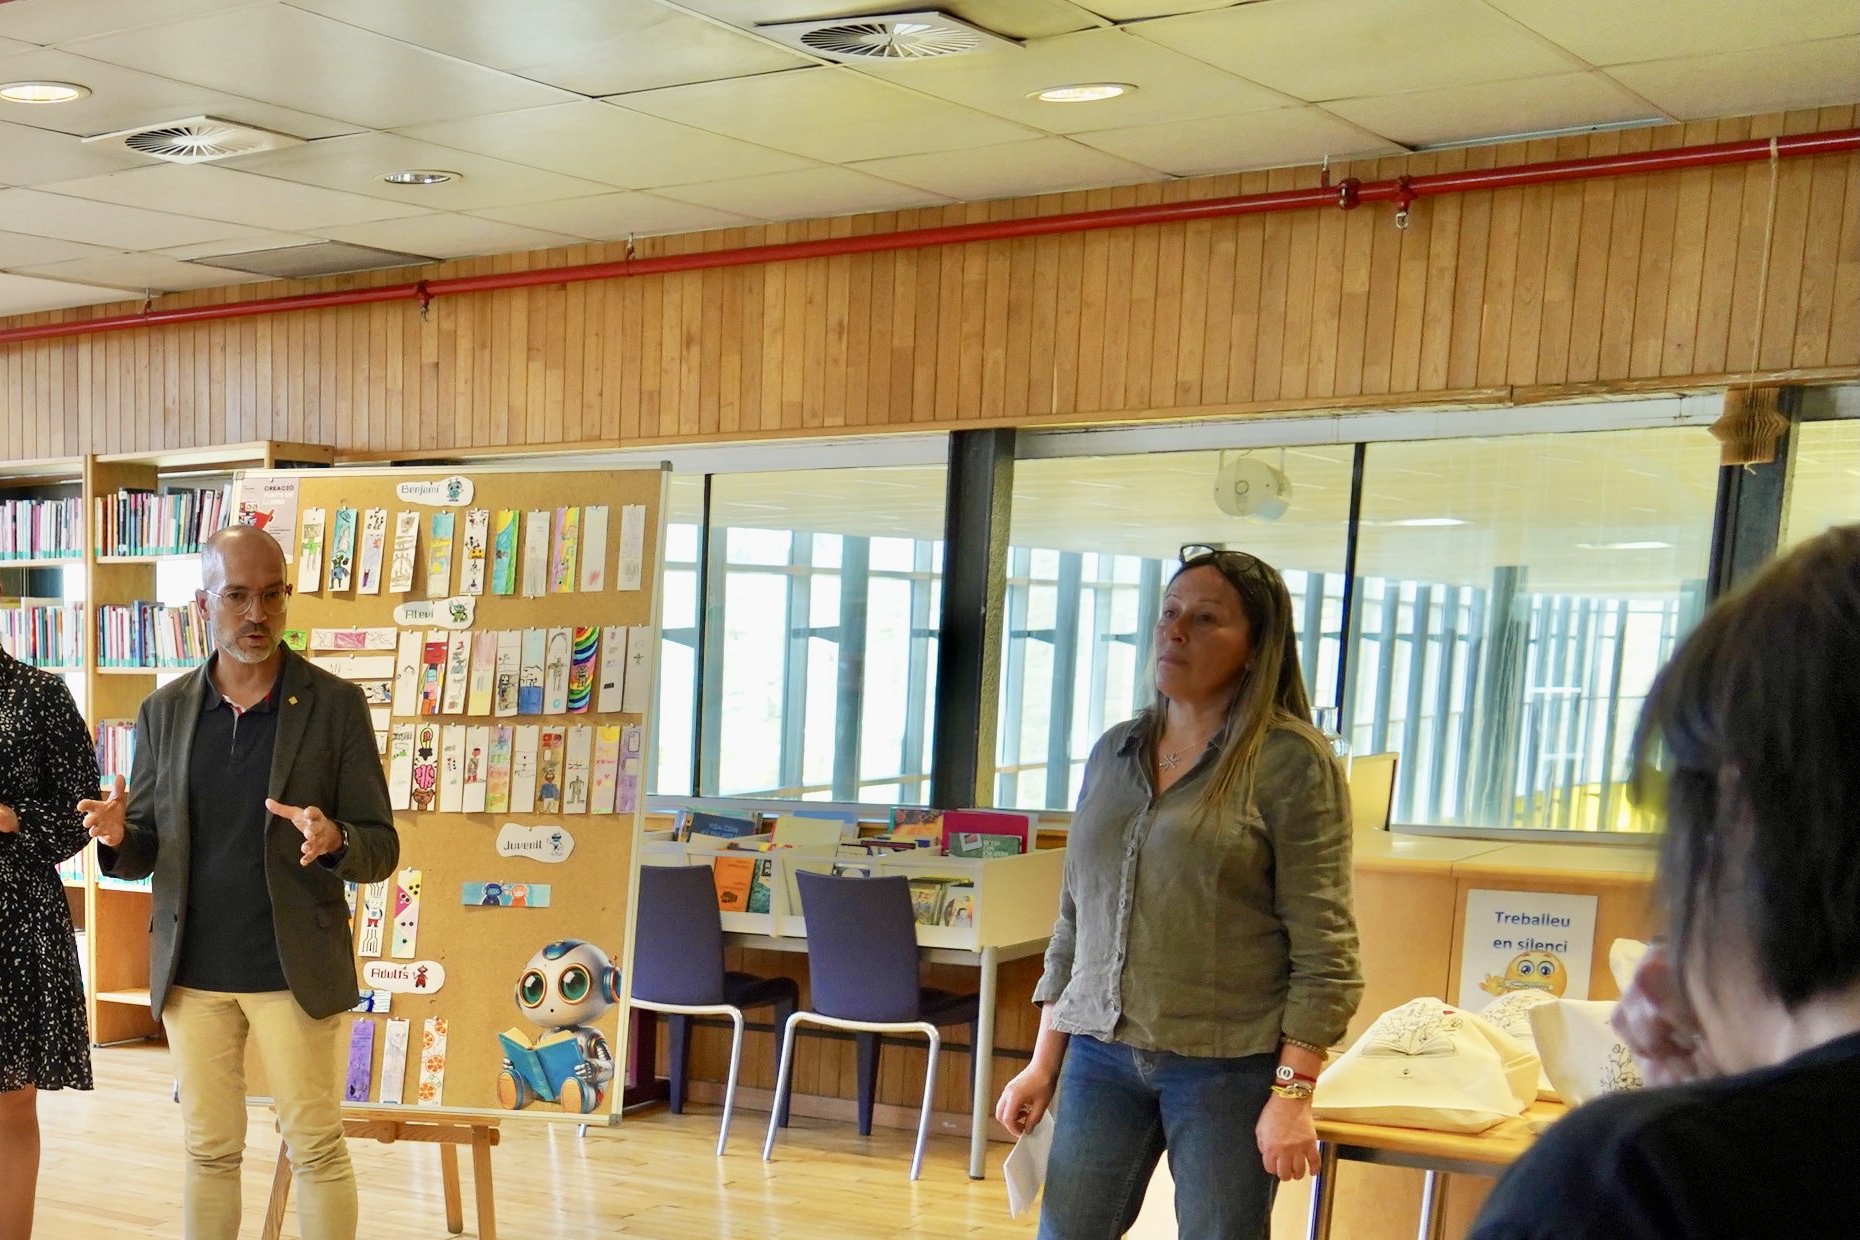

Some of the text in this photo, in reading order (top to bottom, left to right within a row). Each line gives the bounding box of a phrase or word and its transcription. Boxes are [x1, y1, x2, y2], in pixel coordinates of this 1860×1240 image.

[400, 484, 440, 496] Benjamí
[405, 608, 434, 620] Aleví
[503, 840, 543, 851] Juvenil
[1495, 911, 1571, 927] Treballeu
[1493, 938, 1568, 953] en silenci
[371, 968, 409, 980] Adults
